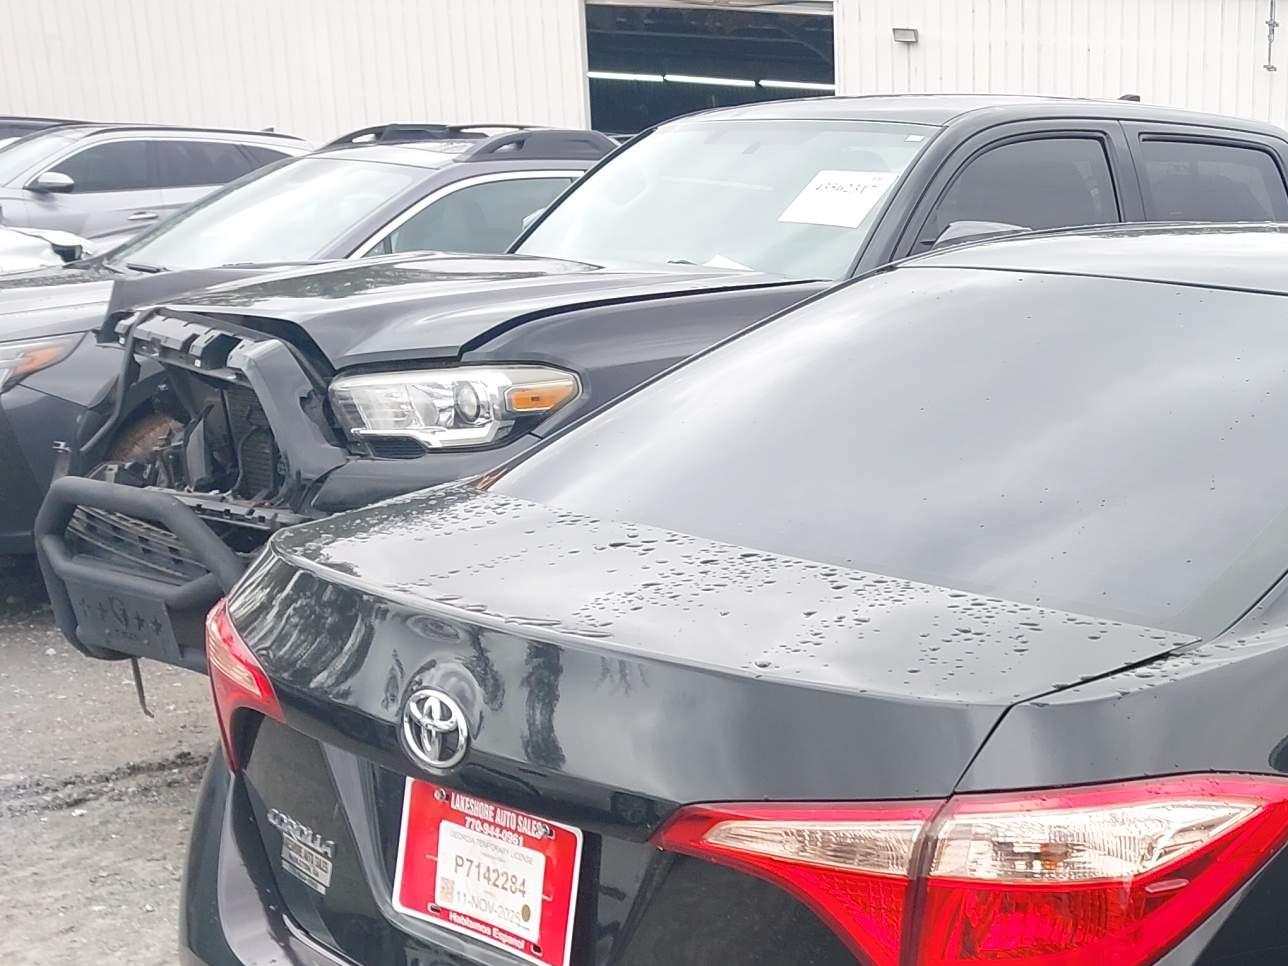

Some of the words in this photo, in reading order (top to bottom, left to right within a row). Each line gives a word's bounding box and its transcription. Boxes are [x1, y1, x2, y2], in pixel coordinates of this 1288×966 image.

[450, 791, 495, 822] LAKESHORE
[495, 807, 517, 830] AUTO
[517, 815, 544, 840] SALES
[454, 854, 527, 899] P7142284
